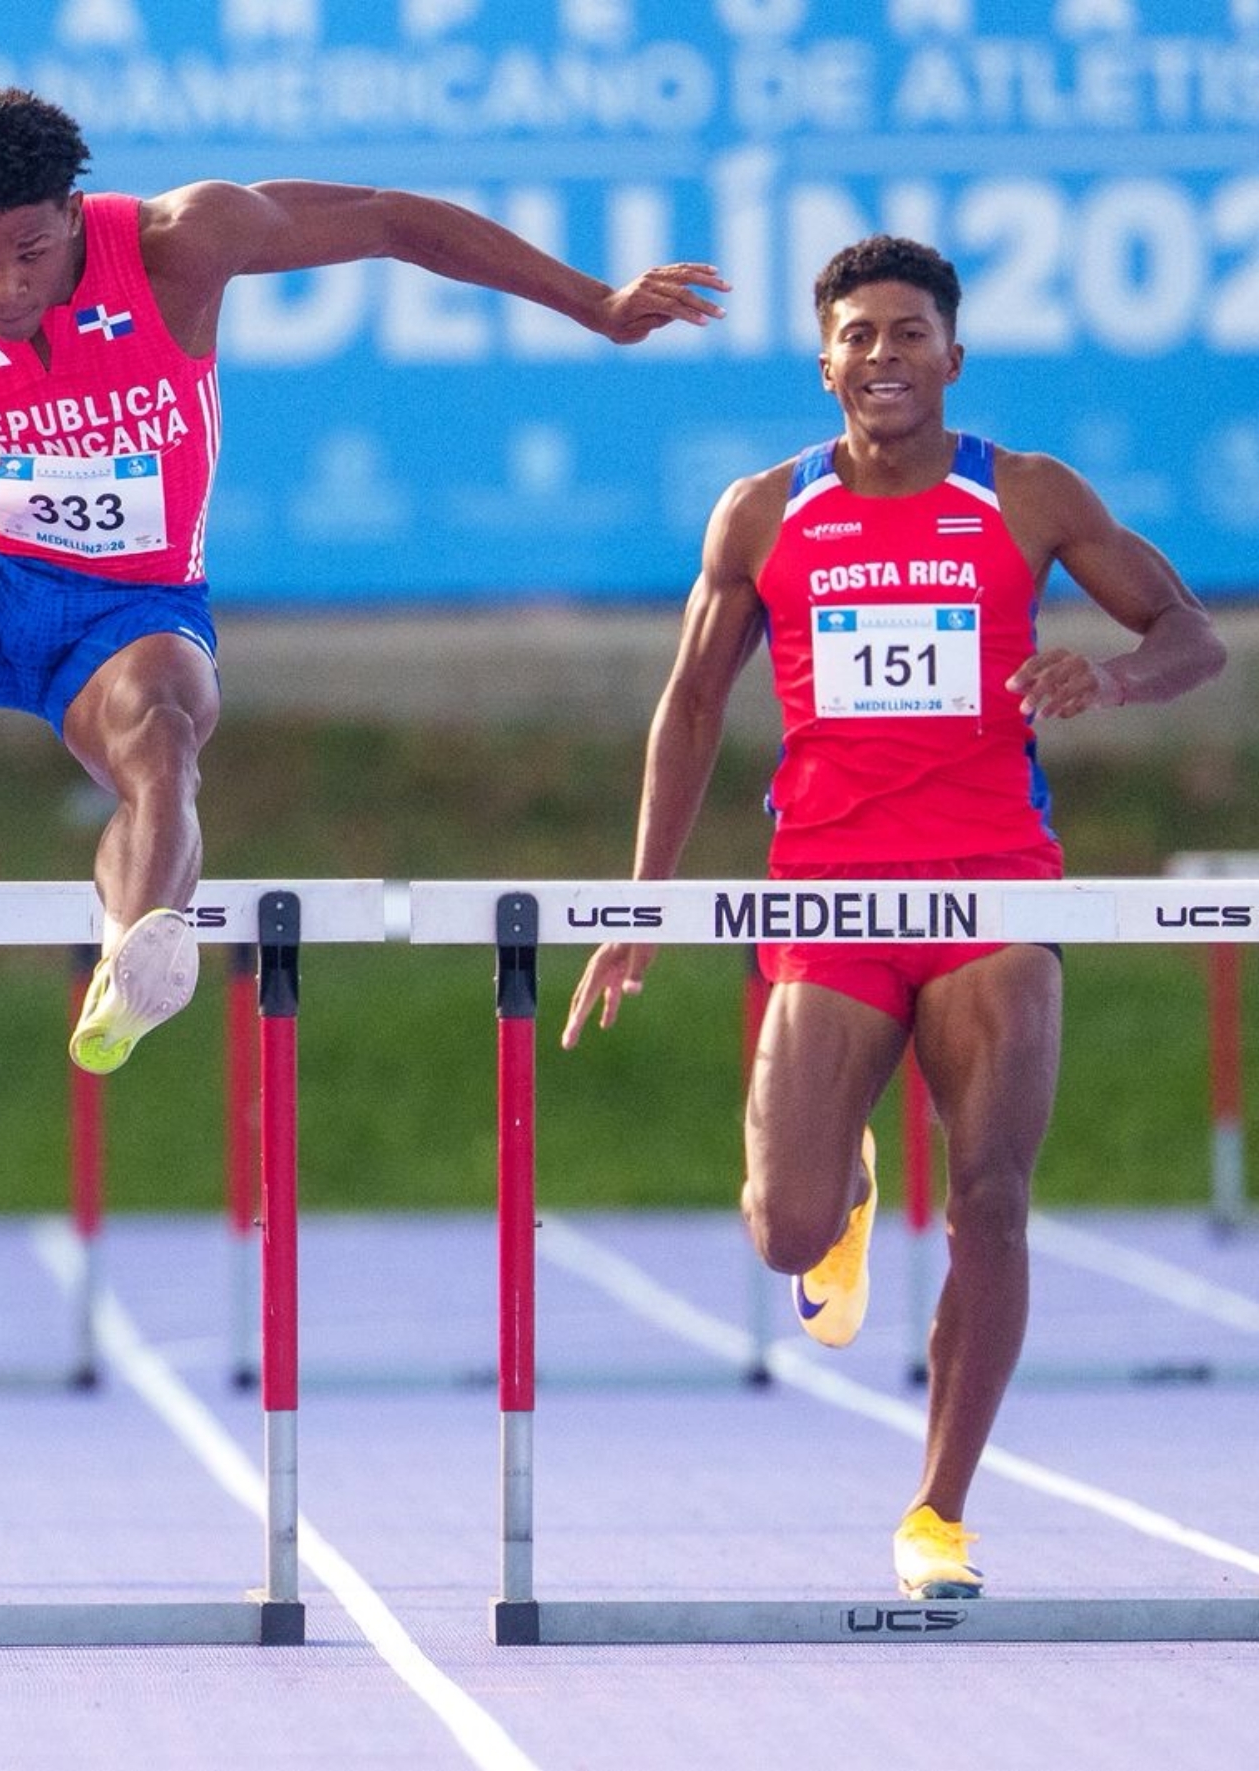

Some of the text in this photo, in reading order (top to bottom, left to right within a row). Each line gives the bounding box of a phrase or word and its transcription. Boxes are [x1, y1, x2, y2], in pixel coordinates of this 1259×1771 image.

[731, 37, 877, 128] DE
[28, 493, 125, 532] 333
[810, 559, 978, 596] COSTA RICA
[854, 643, 937, 687] 151
[568, 892, 1253, 939] UCS MEDELLIN UCS
[847, 1608, 963, 1632] UCS
